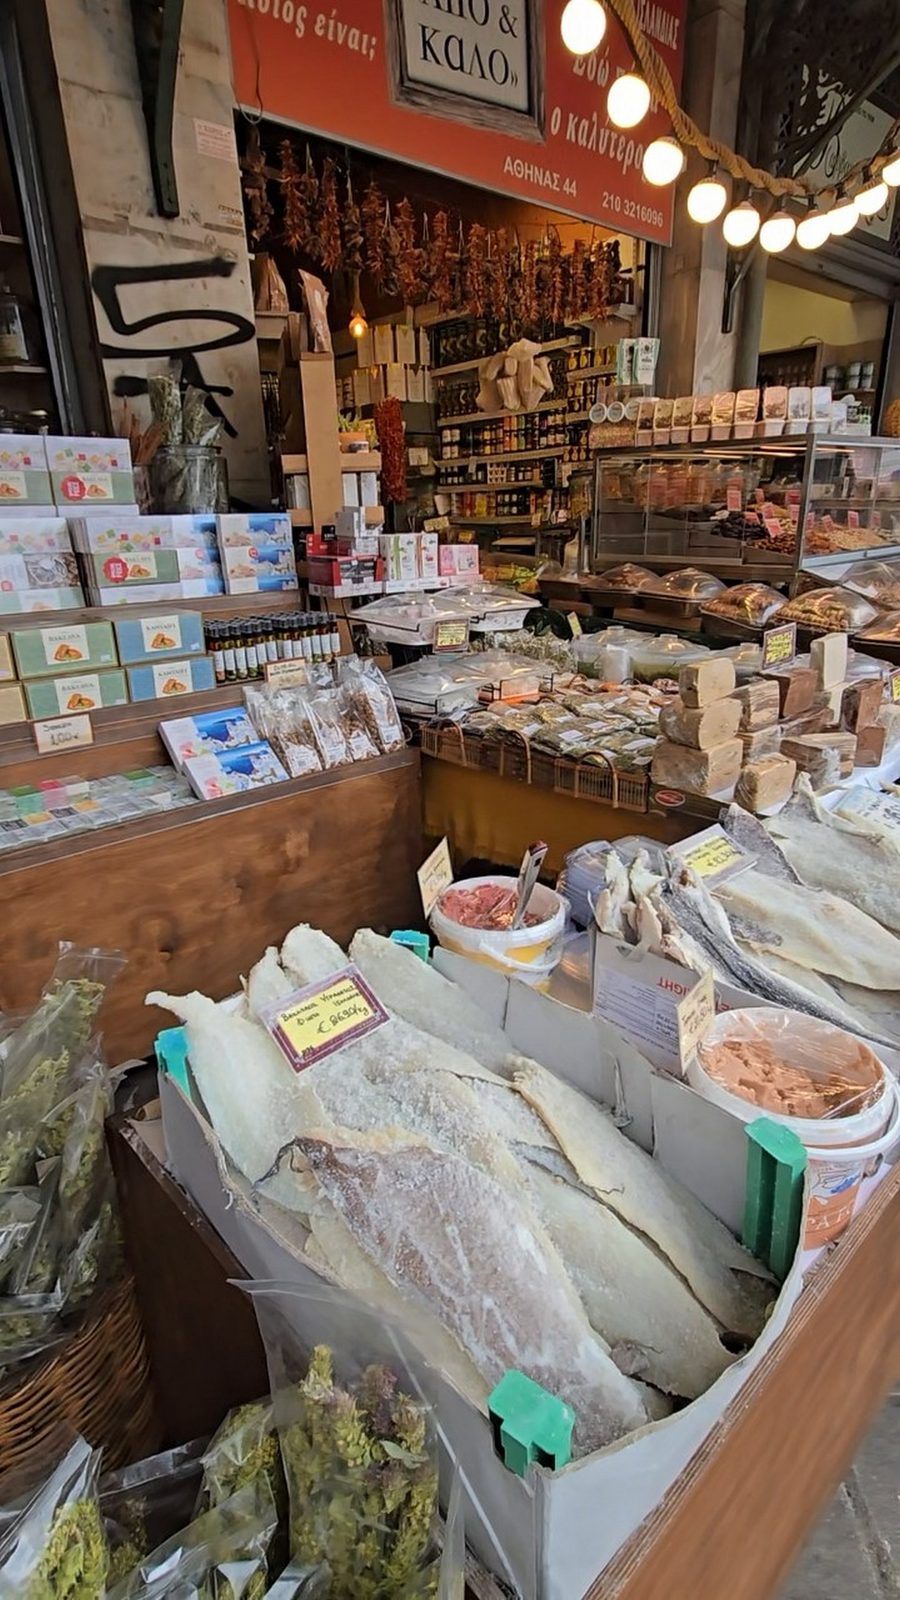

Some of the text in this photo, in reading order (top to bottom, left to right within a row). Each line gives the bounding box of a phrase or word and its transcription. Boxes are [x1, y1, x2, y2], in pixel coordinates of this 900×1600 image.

[499, 4, 517, 38] &
[503, 155, 577, 198] ΑΘΗΝΑΣ 44
[602, 191, 664, 228] 210 3216096
